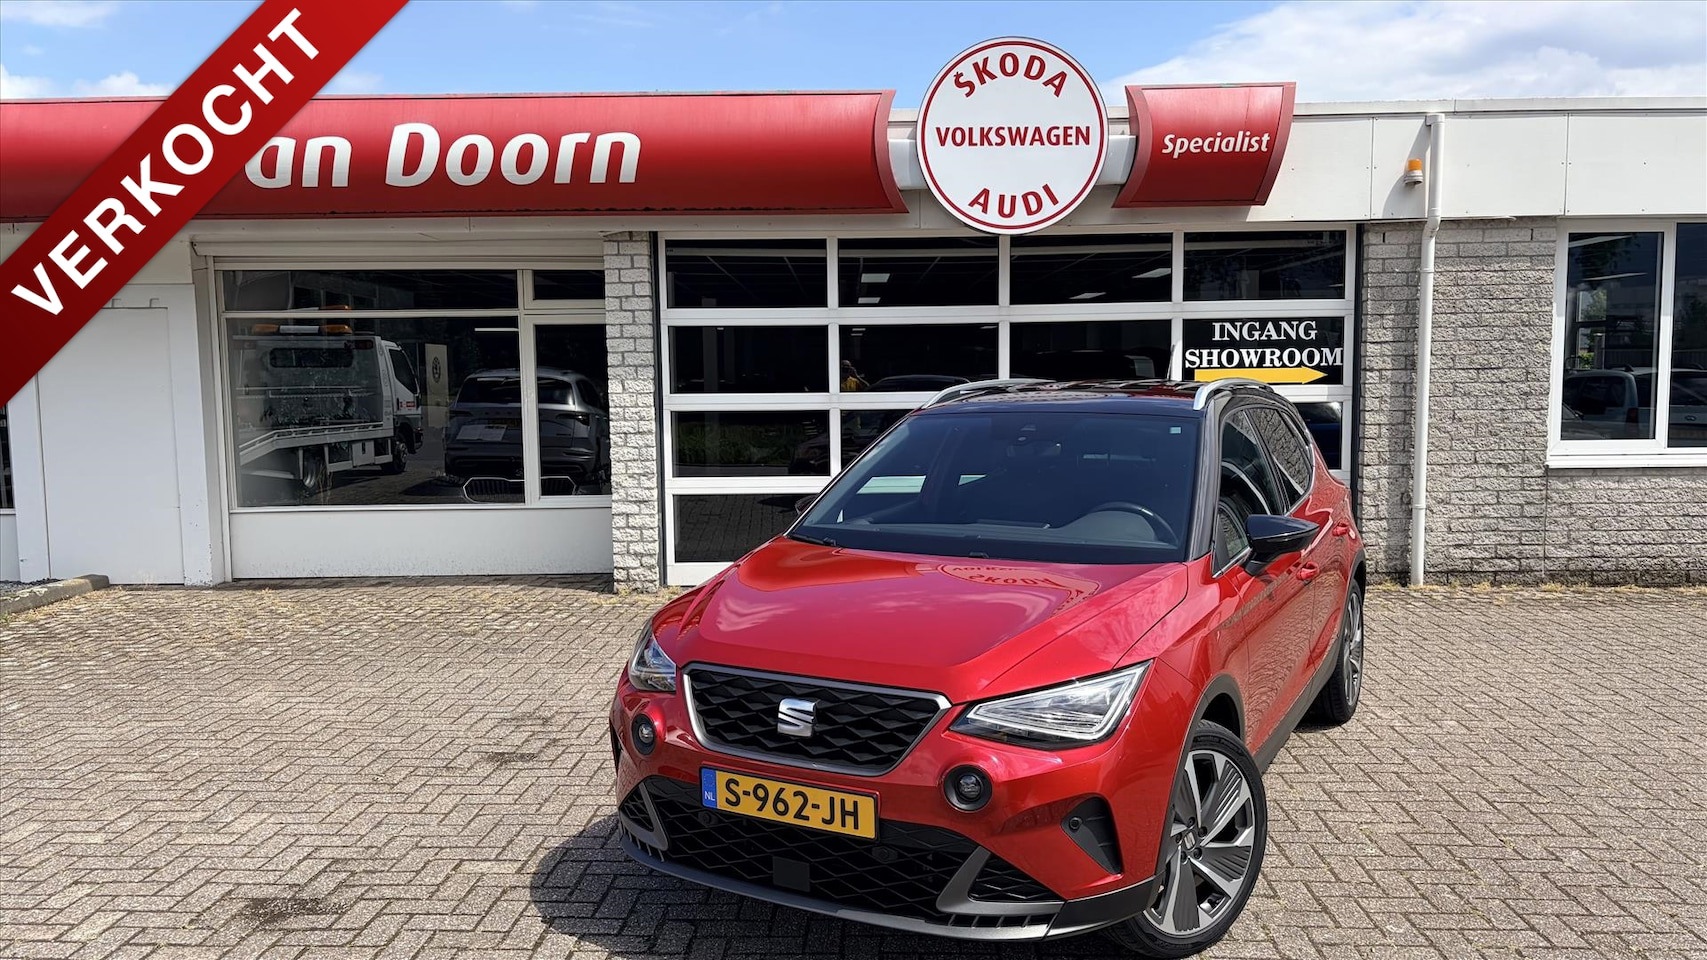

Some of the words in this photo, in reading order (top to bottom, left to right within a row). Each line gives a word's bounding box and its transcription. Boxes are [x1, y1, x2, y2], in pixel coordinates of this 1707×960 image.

[953, 52, 1068, 98] ŠKODA
[935, 126, 1091, 147] VOLKSWAGEN
[1162, 131, 1271, 159] Specialist
[246, 136, 352, 188] an
[385, 122, 641, 187] Doorn
[968, 183, 1059, 219] AUDI
[1211, 321, 1318, 341] INGANG
[1185, 348, 1343, 368] SHOWROOM
[704, 791, 716, 801] NL
[725, 778, 859, 830] S-962-JH
